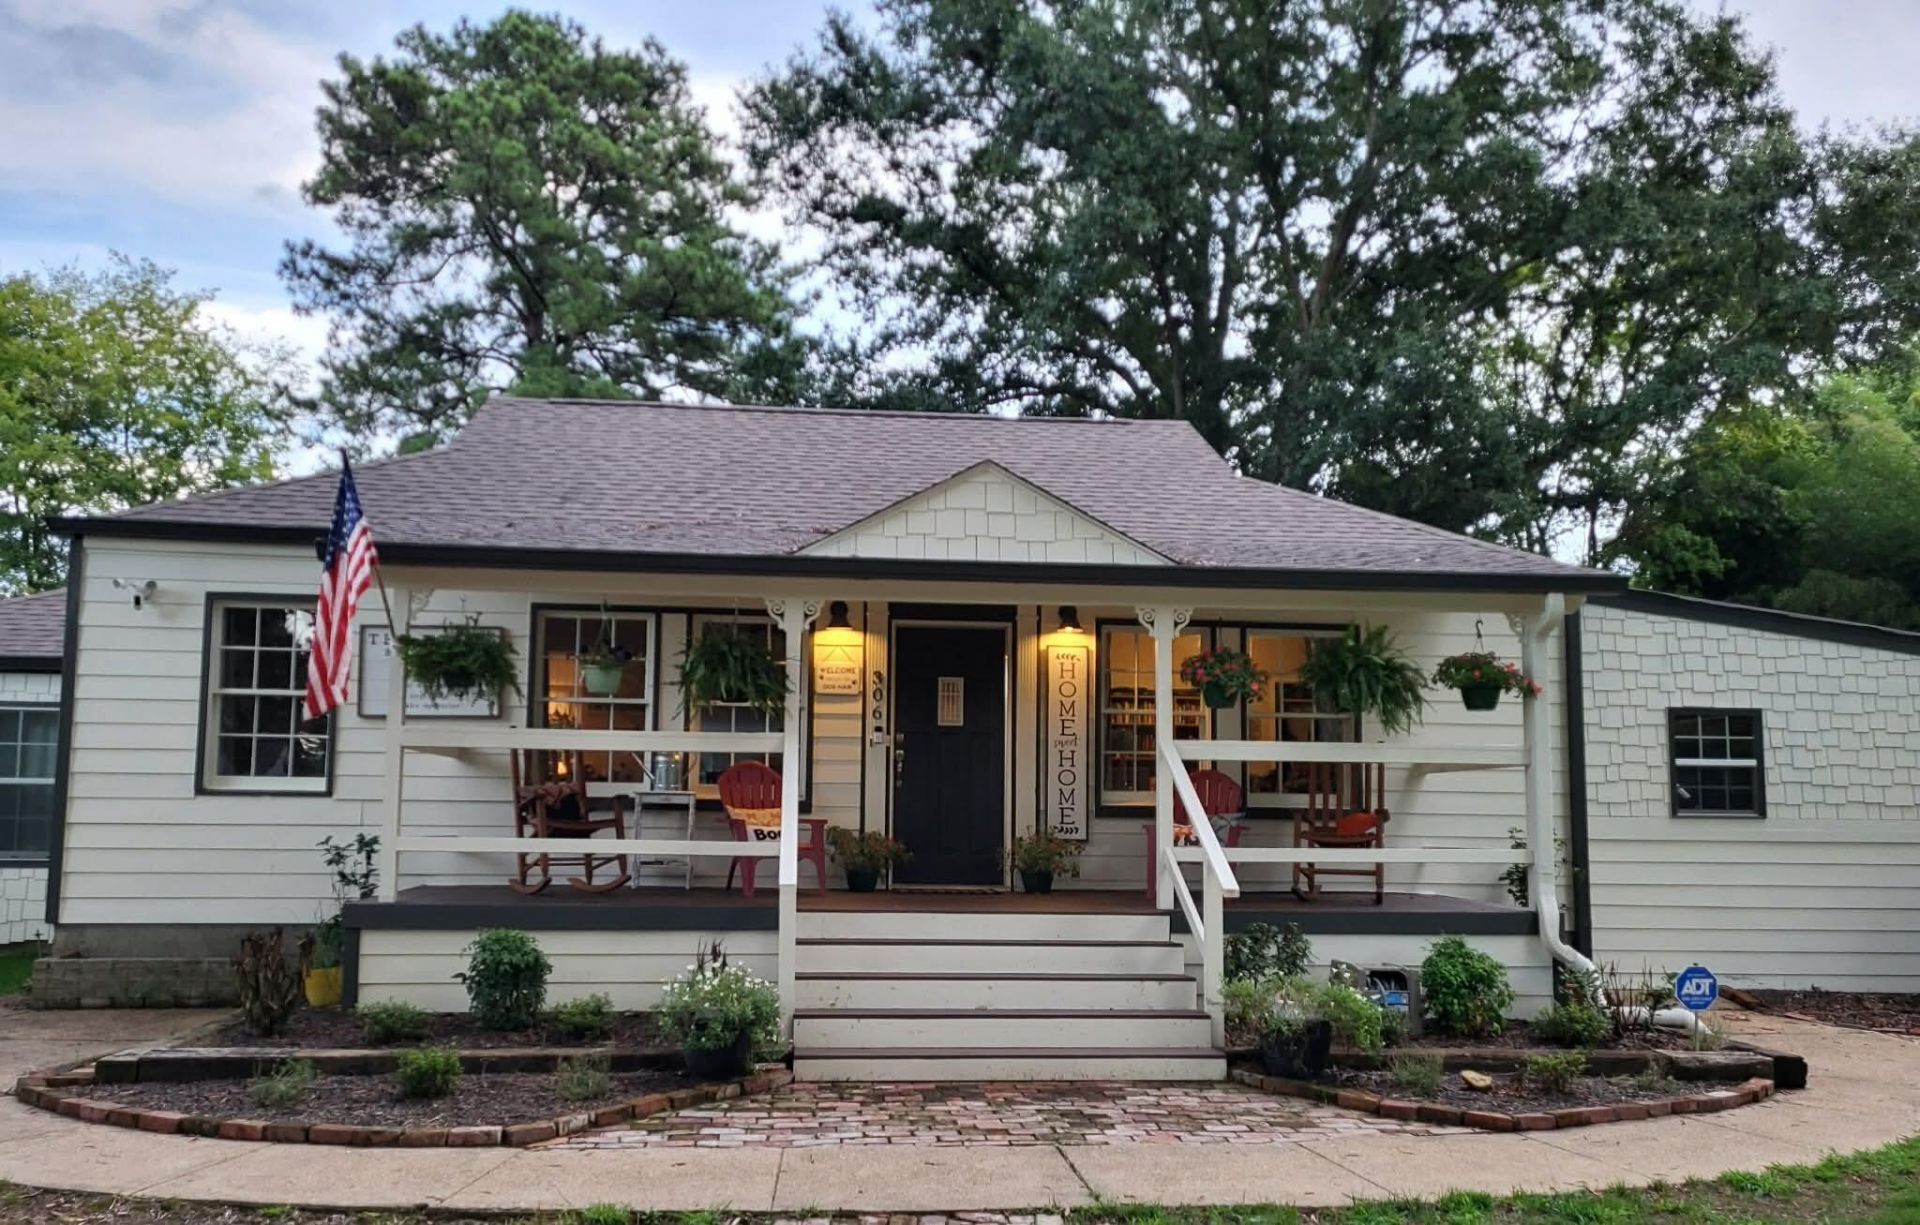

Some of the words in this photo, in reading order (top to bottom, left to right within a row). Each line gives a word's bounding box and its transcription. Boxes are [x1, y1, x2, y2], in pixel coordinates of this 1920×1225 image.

[1058, 662, 1078, 737] HOME
[1054, 734, 1079, 748] sweet
[1058, 749, 1077, 825] HOME
[753, 828, 781, 841] Bo
[1682, 978, 1714, 996] ADT
